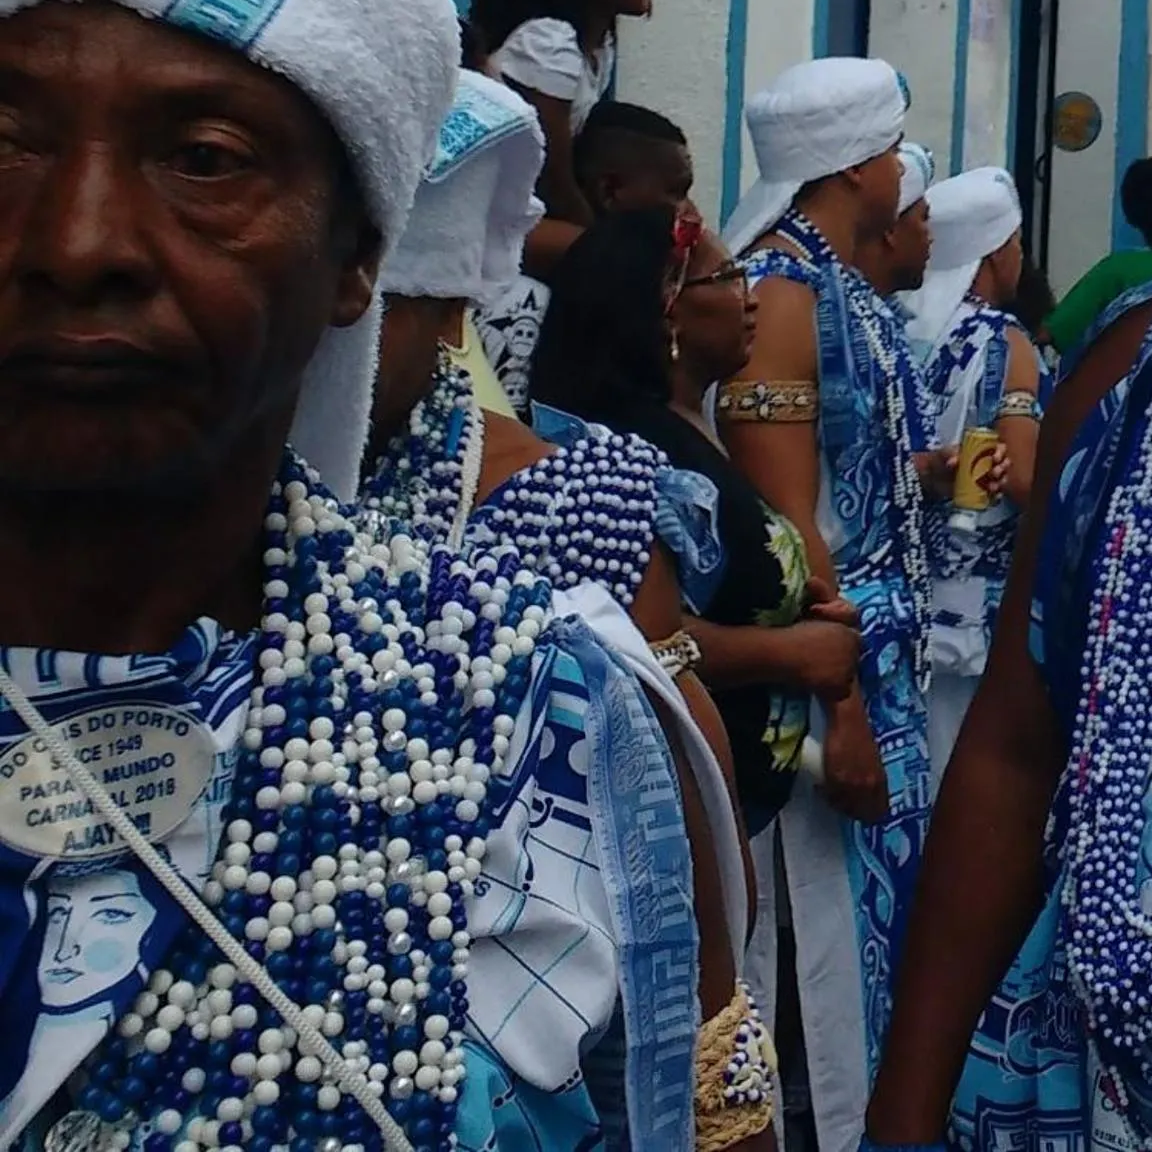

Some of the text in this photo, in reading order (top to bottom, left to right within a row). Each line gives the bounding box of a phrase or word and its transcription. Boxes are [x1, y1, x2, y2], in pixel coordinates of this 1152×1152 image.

[0, 710, 190, 779] DO CIS DO PORTO
[107, 735, 143, 758] 1949
[20, 778, 75, 802] PARA
[102, 752, 176, 785] MUNDO
[26, 792, 130, 828] CARNAAL
